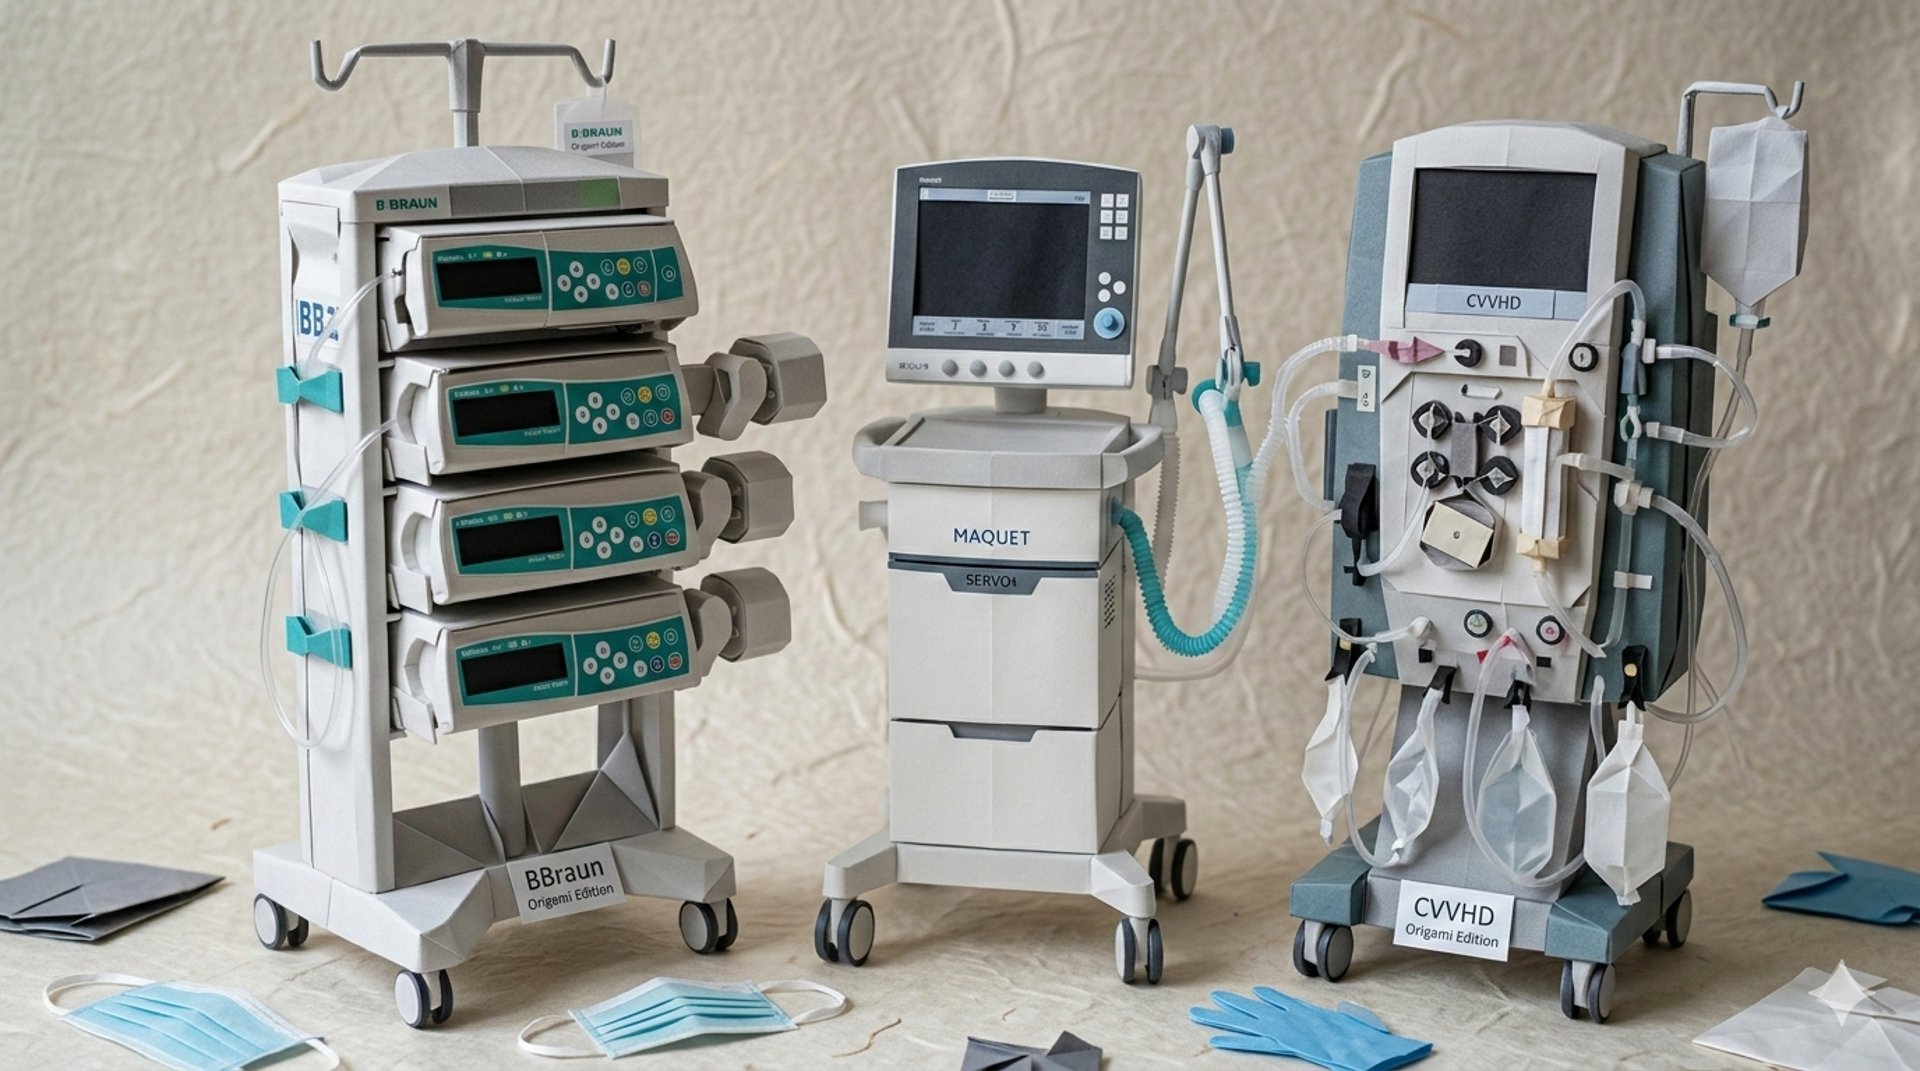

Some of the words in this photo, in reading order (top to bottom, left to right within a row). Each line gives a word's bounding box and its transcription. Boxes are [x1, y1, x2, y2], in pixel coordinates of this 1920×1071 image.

[1466, 293, 1521, 310] CVVHD
[954, 528, 1030, 546] MAQUET
[525, 860, 604, 891] BBraun
[1414, 896, 1495, 926] CVVHD
[1405, 922, 1454, 941] Origami
[1456, 930, 1499, 948] Edition
